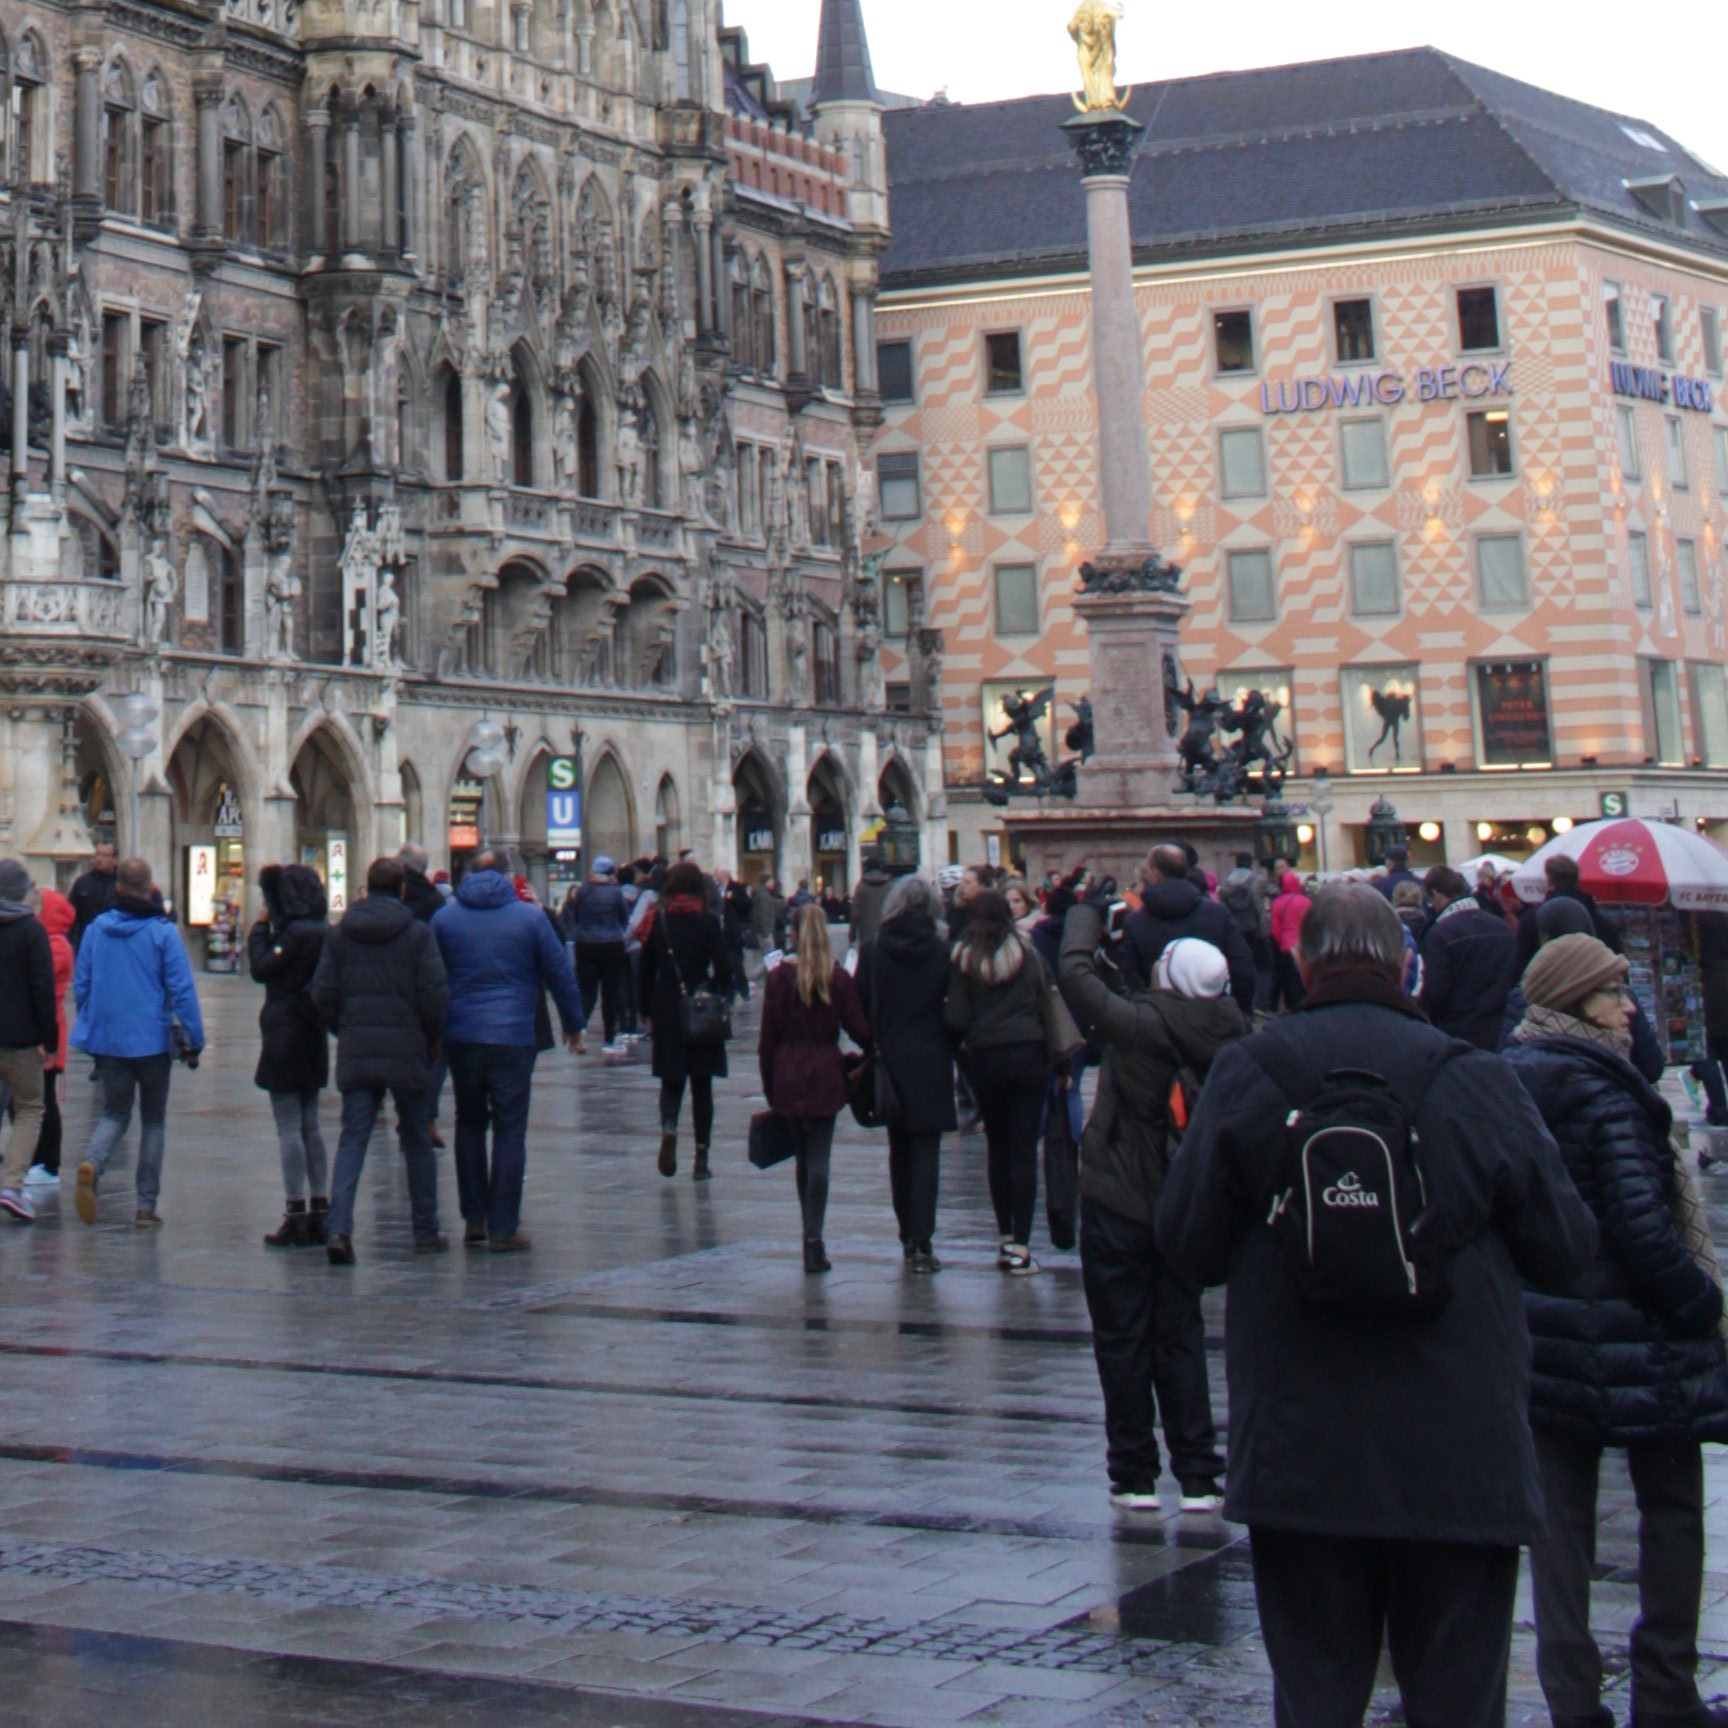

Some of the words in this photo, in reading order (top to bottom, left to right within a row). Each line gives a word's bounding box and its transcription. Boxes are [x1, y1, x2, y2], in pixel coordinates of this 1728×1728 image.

[1260, 370, 1405, 415] LUDWIG
[1415, 360, 1514, 402] BECK
[551, 758, 575, 789] S
[552, 795, 574, 825] U
[1603, 793, 1623, 816] S
[1679, 891, 1692, 903] FC
[1695, 892, 1728, 904] BAYER
[1321, 1186, 1380, 1207] Costa
